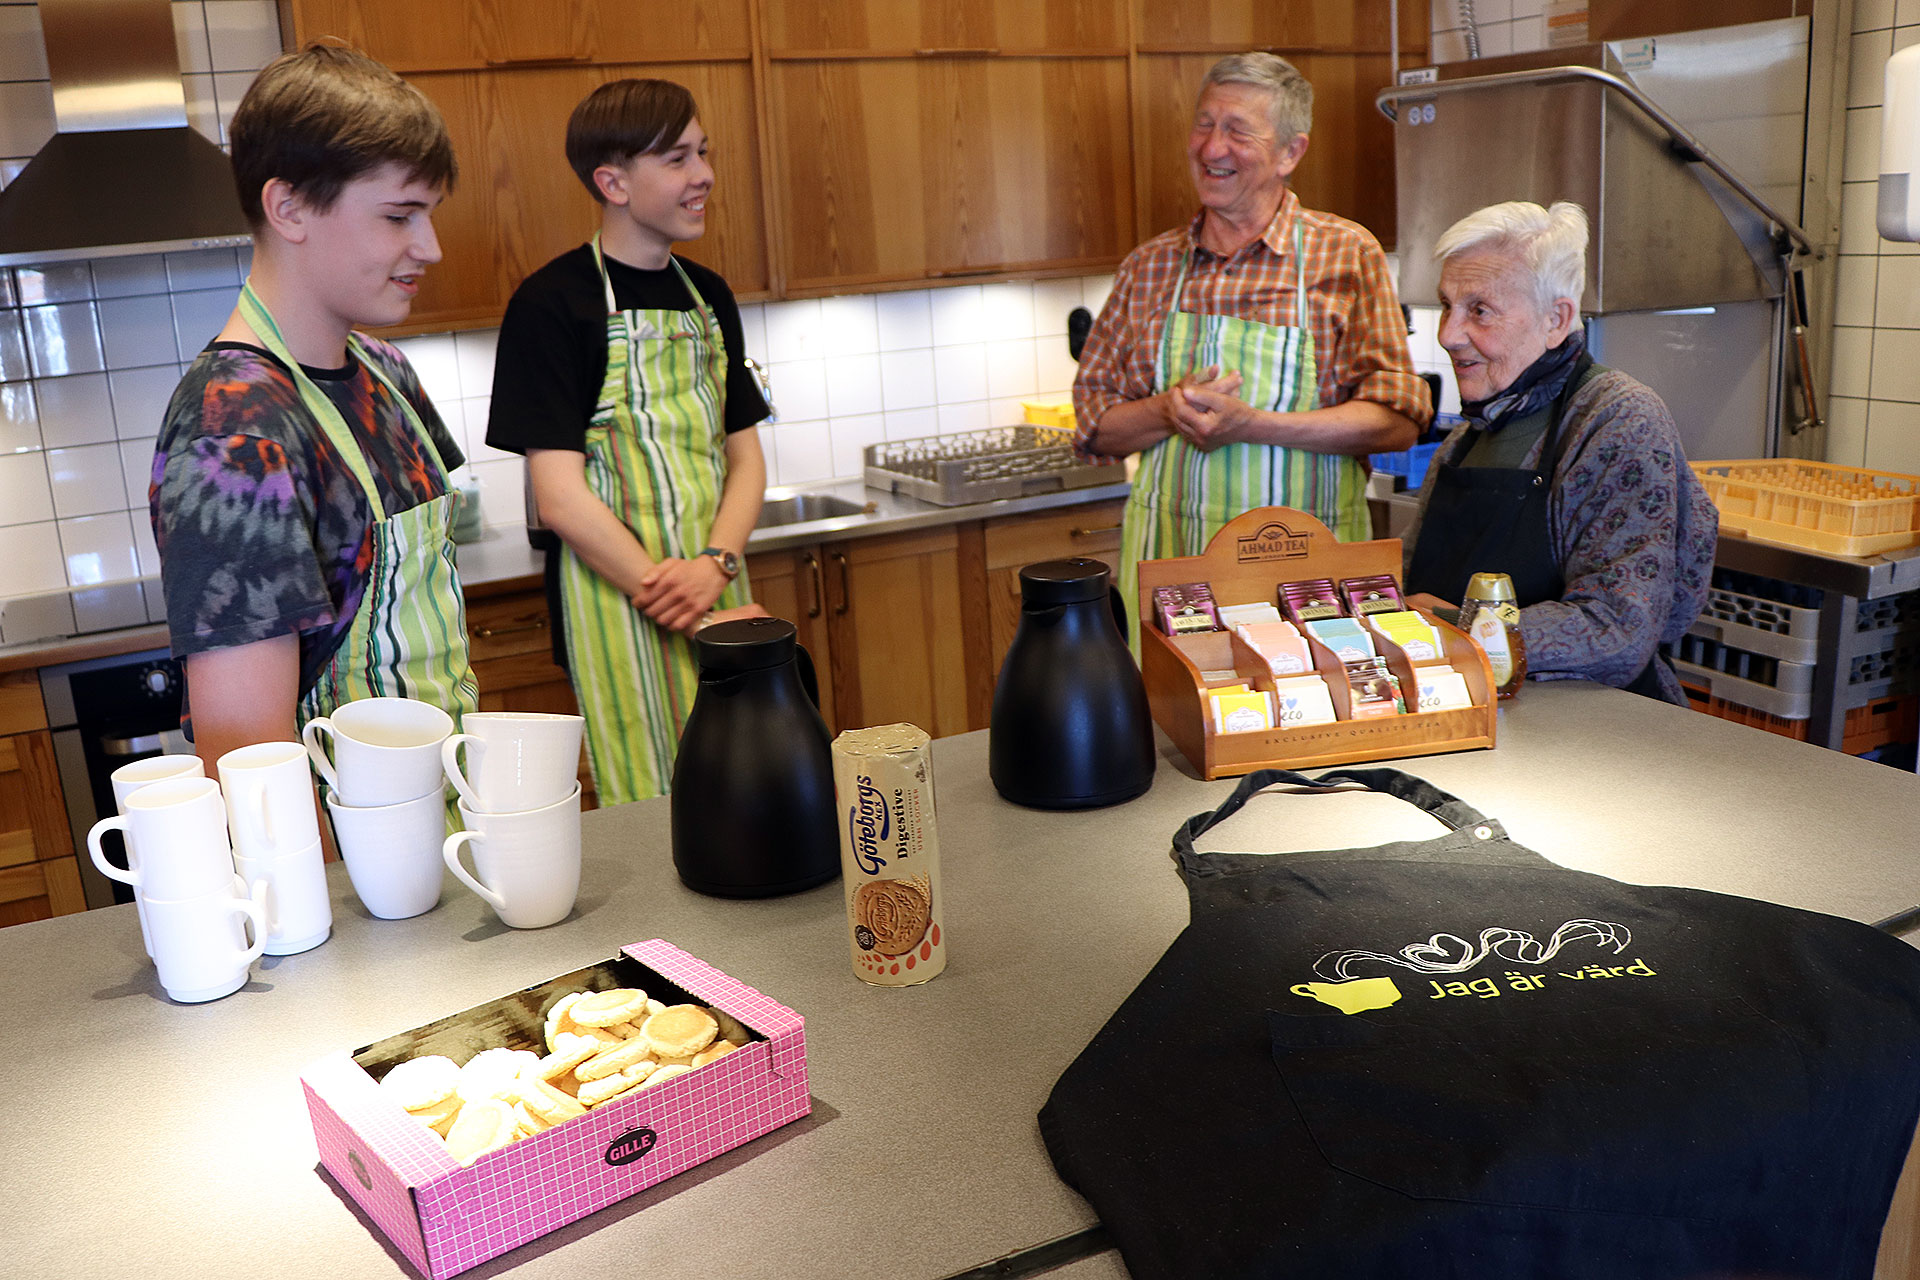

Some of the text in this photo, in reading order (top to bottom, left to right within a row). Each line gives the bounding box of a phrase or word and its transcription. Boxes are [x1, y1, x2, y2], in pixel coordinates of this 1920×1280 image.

[1240, 540, 1306, 554] AHMAD TEA
[1265, 732, 1340, 744] EXCLUSIVE
[1350, 725, 1407, 736] QUALITY
[874, 801, 883, 821] KEX
[892, 788, 910, 859] Digestive
[850, 775, 890, 876] Göteborgs
[1429, 958, 1658, 999] Jag är värd
[610, 1133, 652, 1161] GILLE
